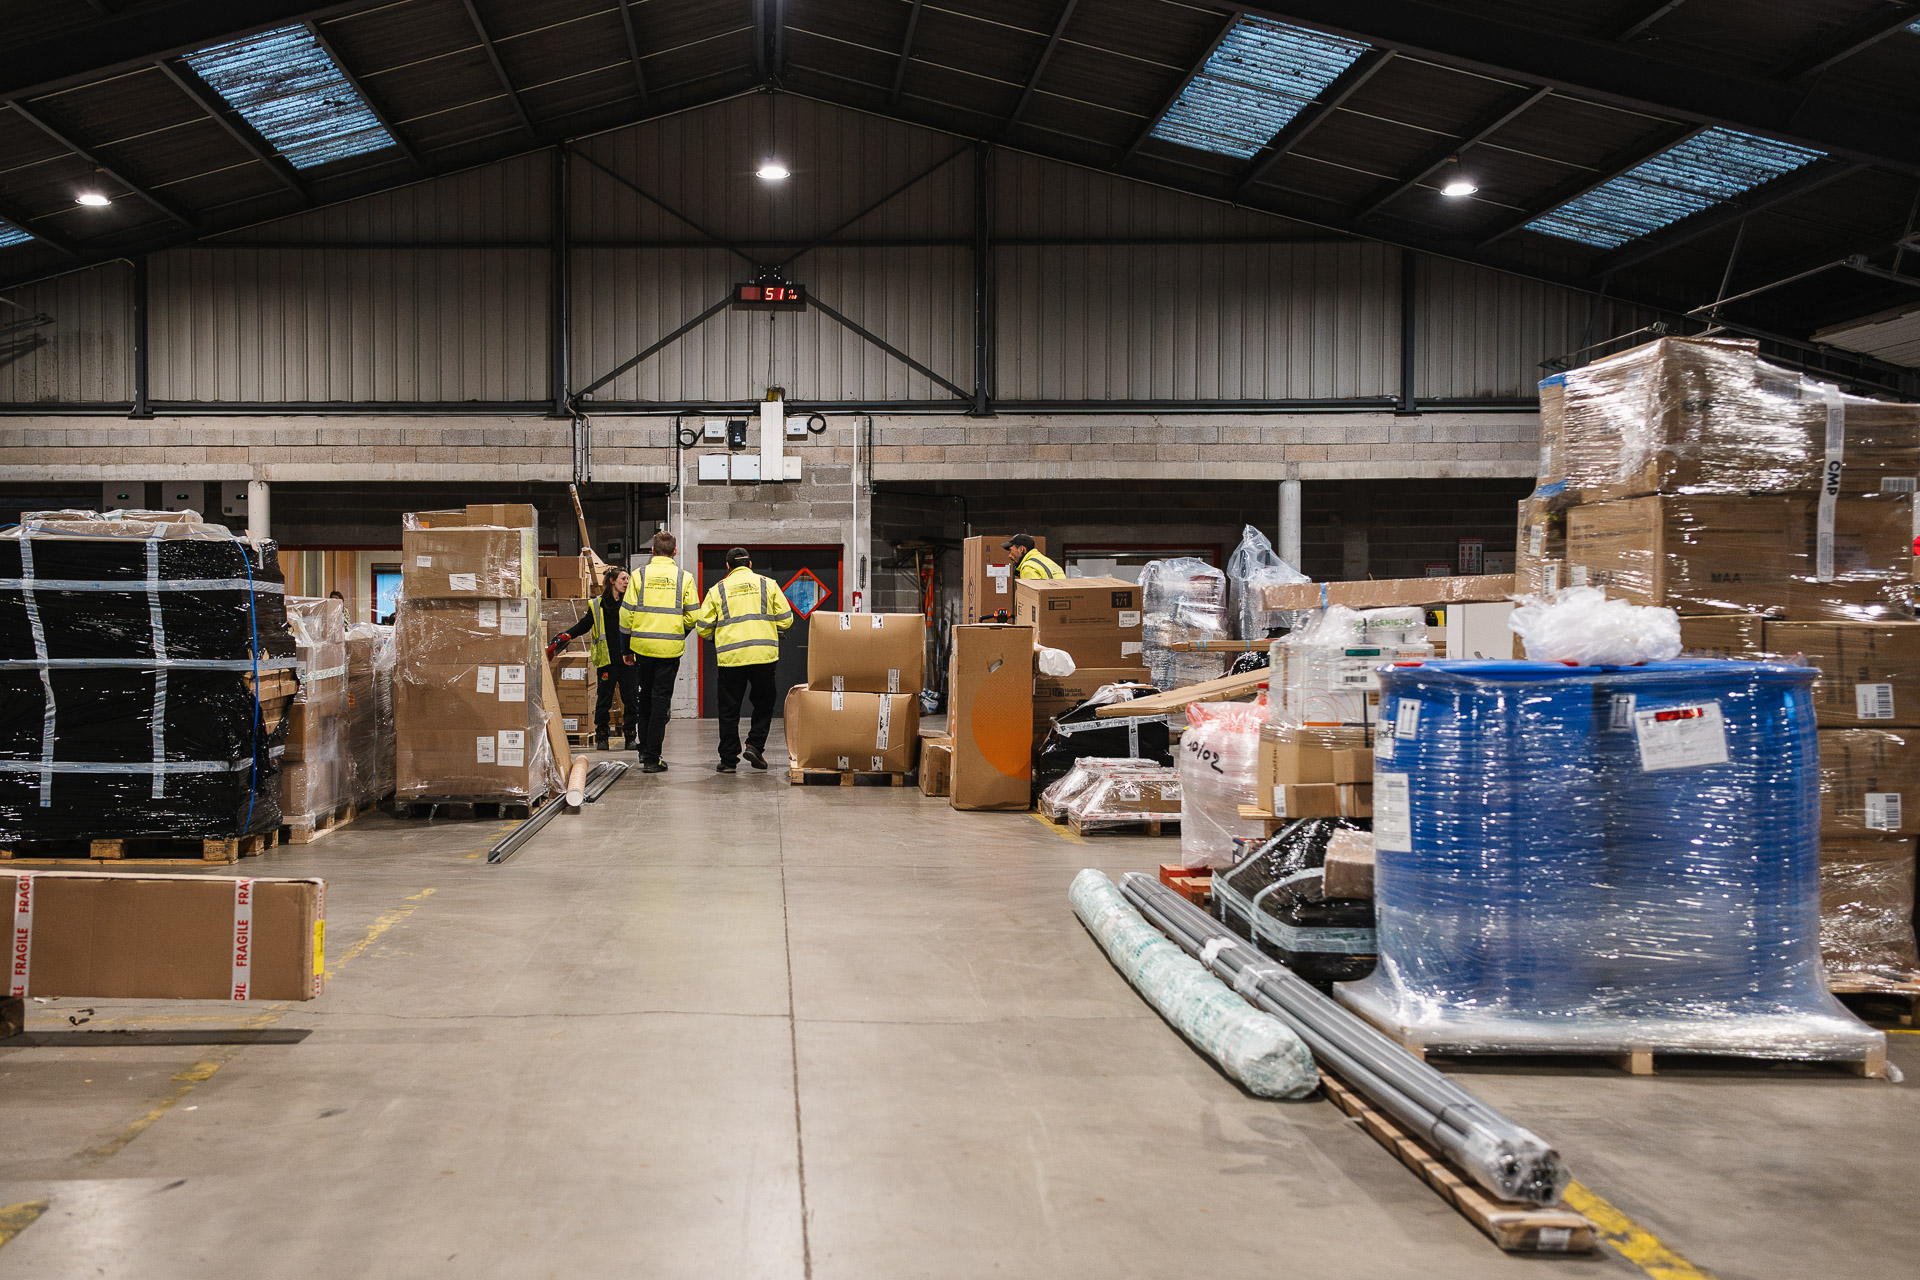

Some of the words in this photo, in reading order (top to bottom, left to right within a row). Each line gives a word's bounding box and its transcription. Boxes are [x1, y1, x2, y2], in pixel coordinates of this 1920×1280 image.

[765, 287, 784, 300] 51
[1826, 460, 1841, 496] CMP
[1710, 572, 1742, 584] MAA
[1187, 741, 1224, 774] 10/02
[15, 928, 29, 975] FRAGILE
[236, 919, 249, 967] FRAGILE
